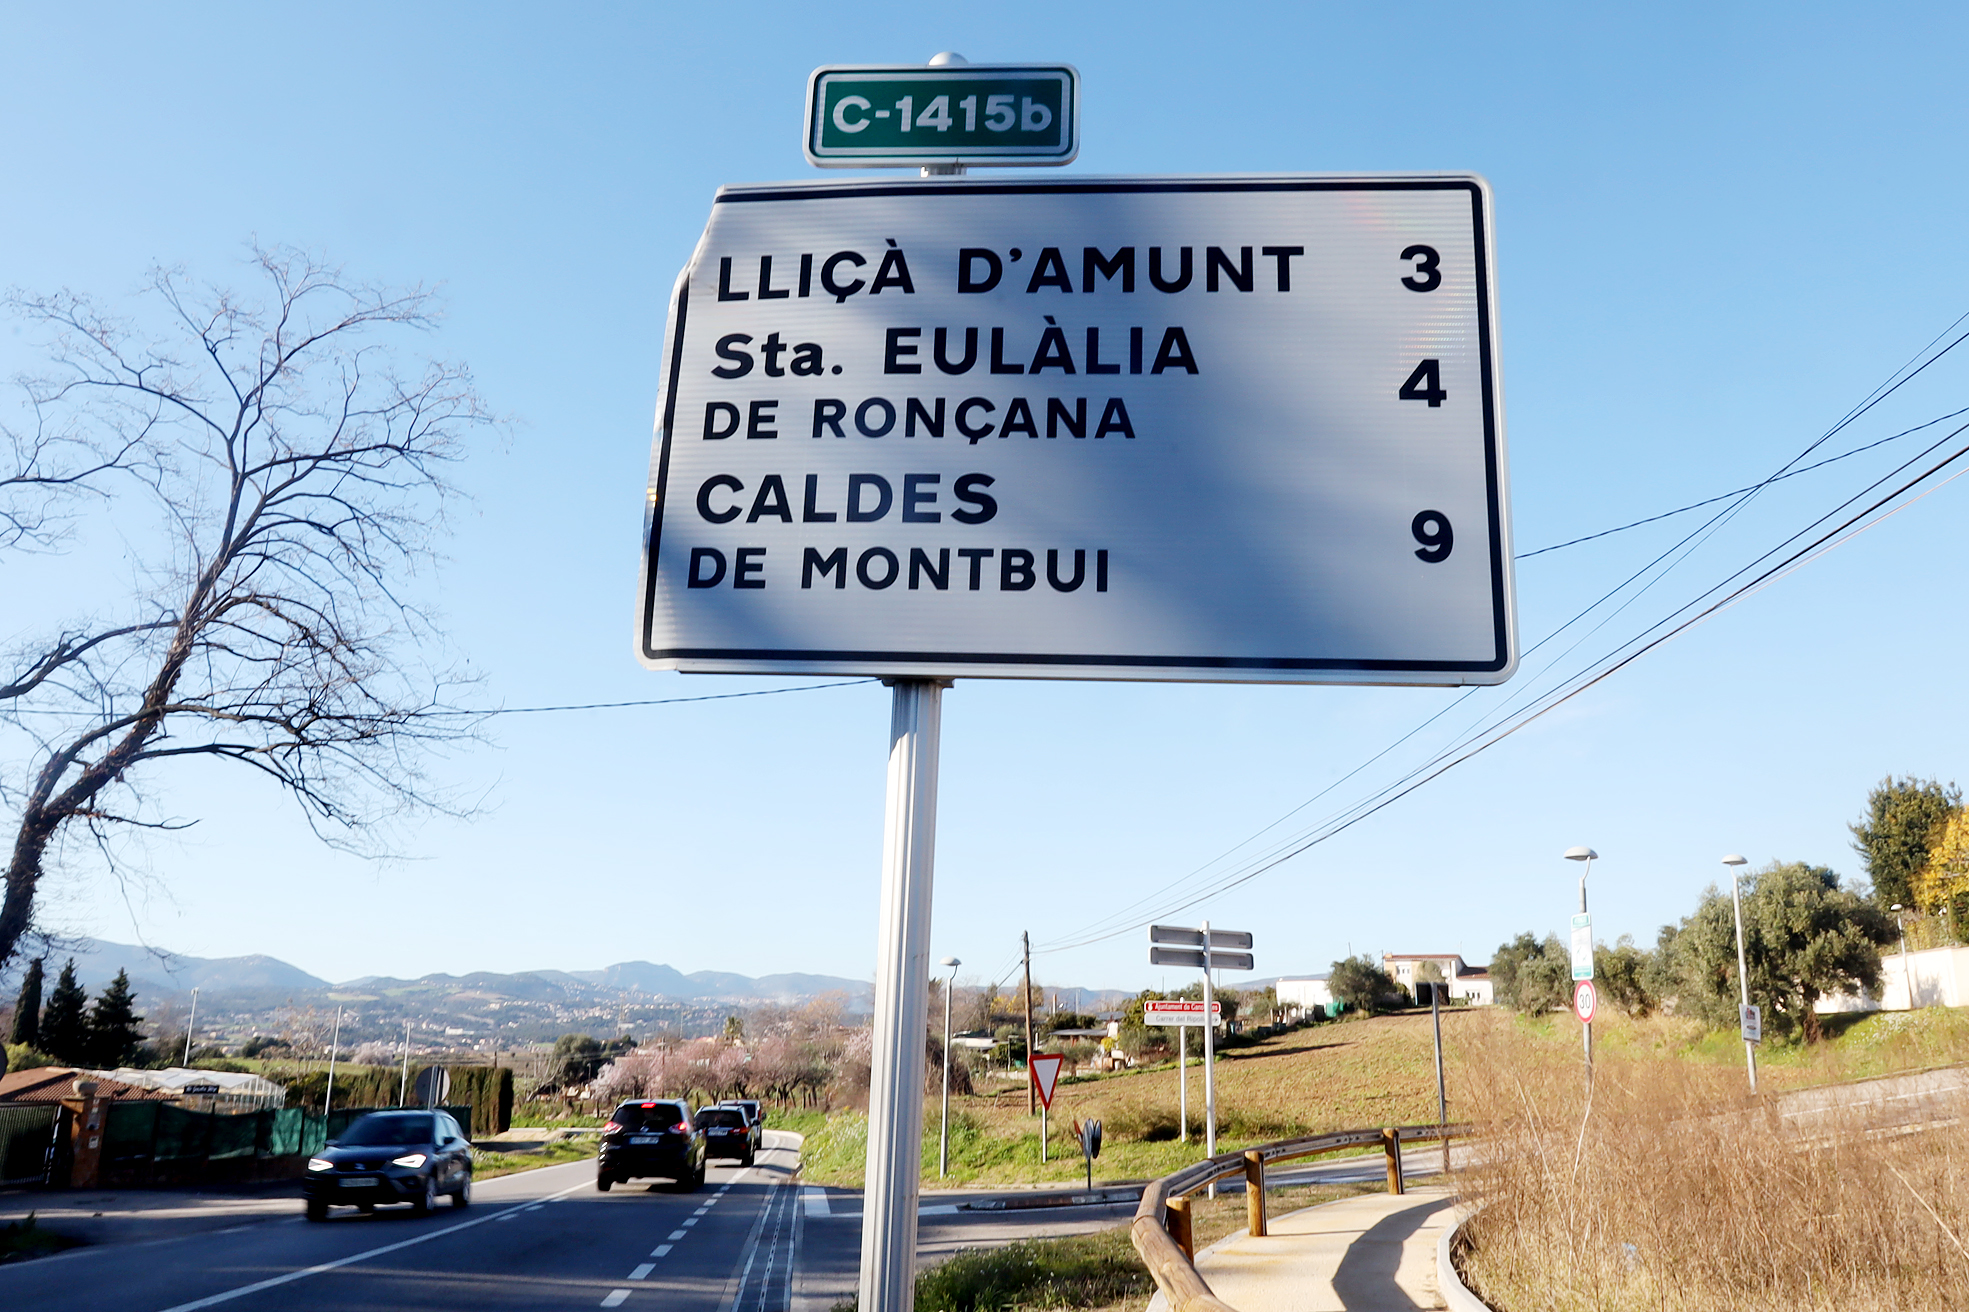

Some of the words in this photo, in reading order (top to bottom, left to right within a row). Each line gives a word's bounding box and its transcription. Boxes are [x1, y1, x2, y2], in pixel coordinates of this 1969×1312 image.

[832, 94, 1053, 133] C-1415b
[717, 238, 916, 303] LLIÇÀ
[957, 245, 1305, 294] D'AMUNT
[1399, 244, 1442, 293] 3
[713, 331, 843, 378] Sta.
[883, 315, 1200, 376] EULÀLIA
[1398, 358, 1448, 408] 4
[702, 399, 780, 441] DE
[811, 396, 1137, 446] RONÇANA
[696, 473, 999, 525] CALDES
[1411, 509, 1455, 564] 9
[686, 546, 768, 591] DE
[800, 546, 1109, 593] MONTBUI
[1579, 994, 1591, 1009] 30
